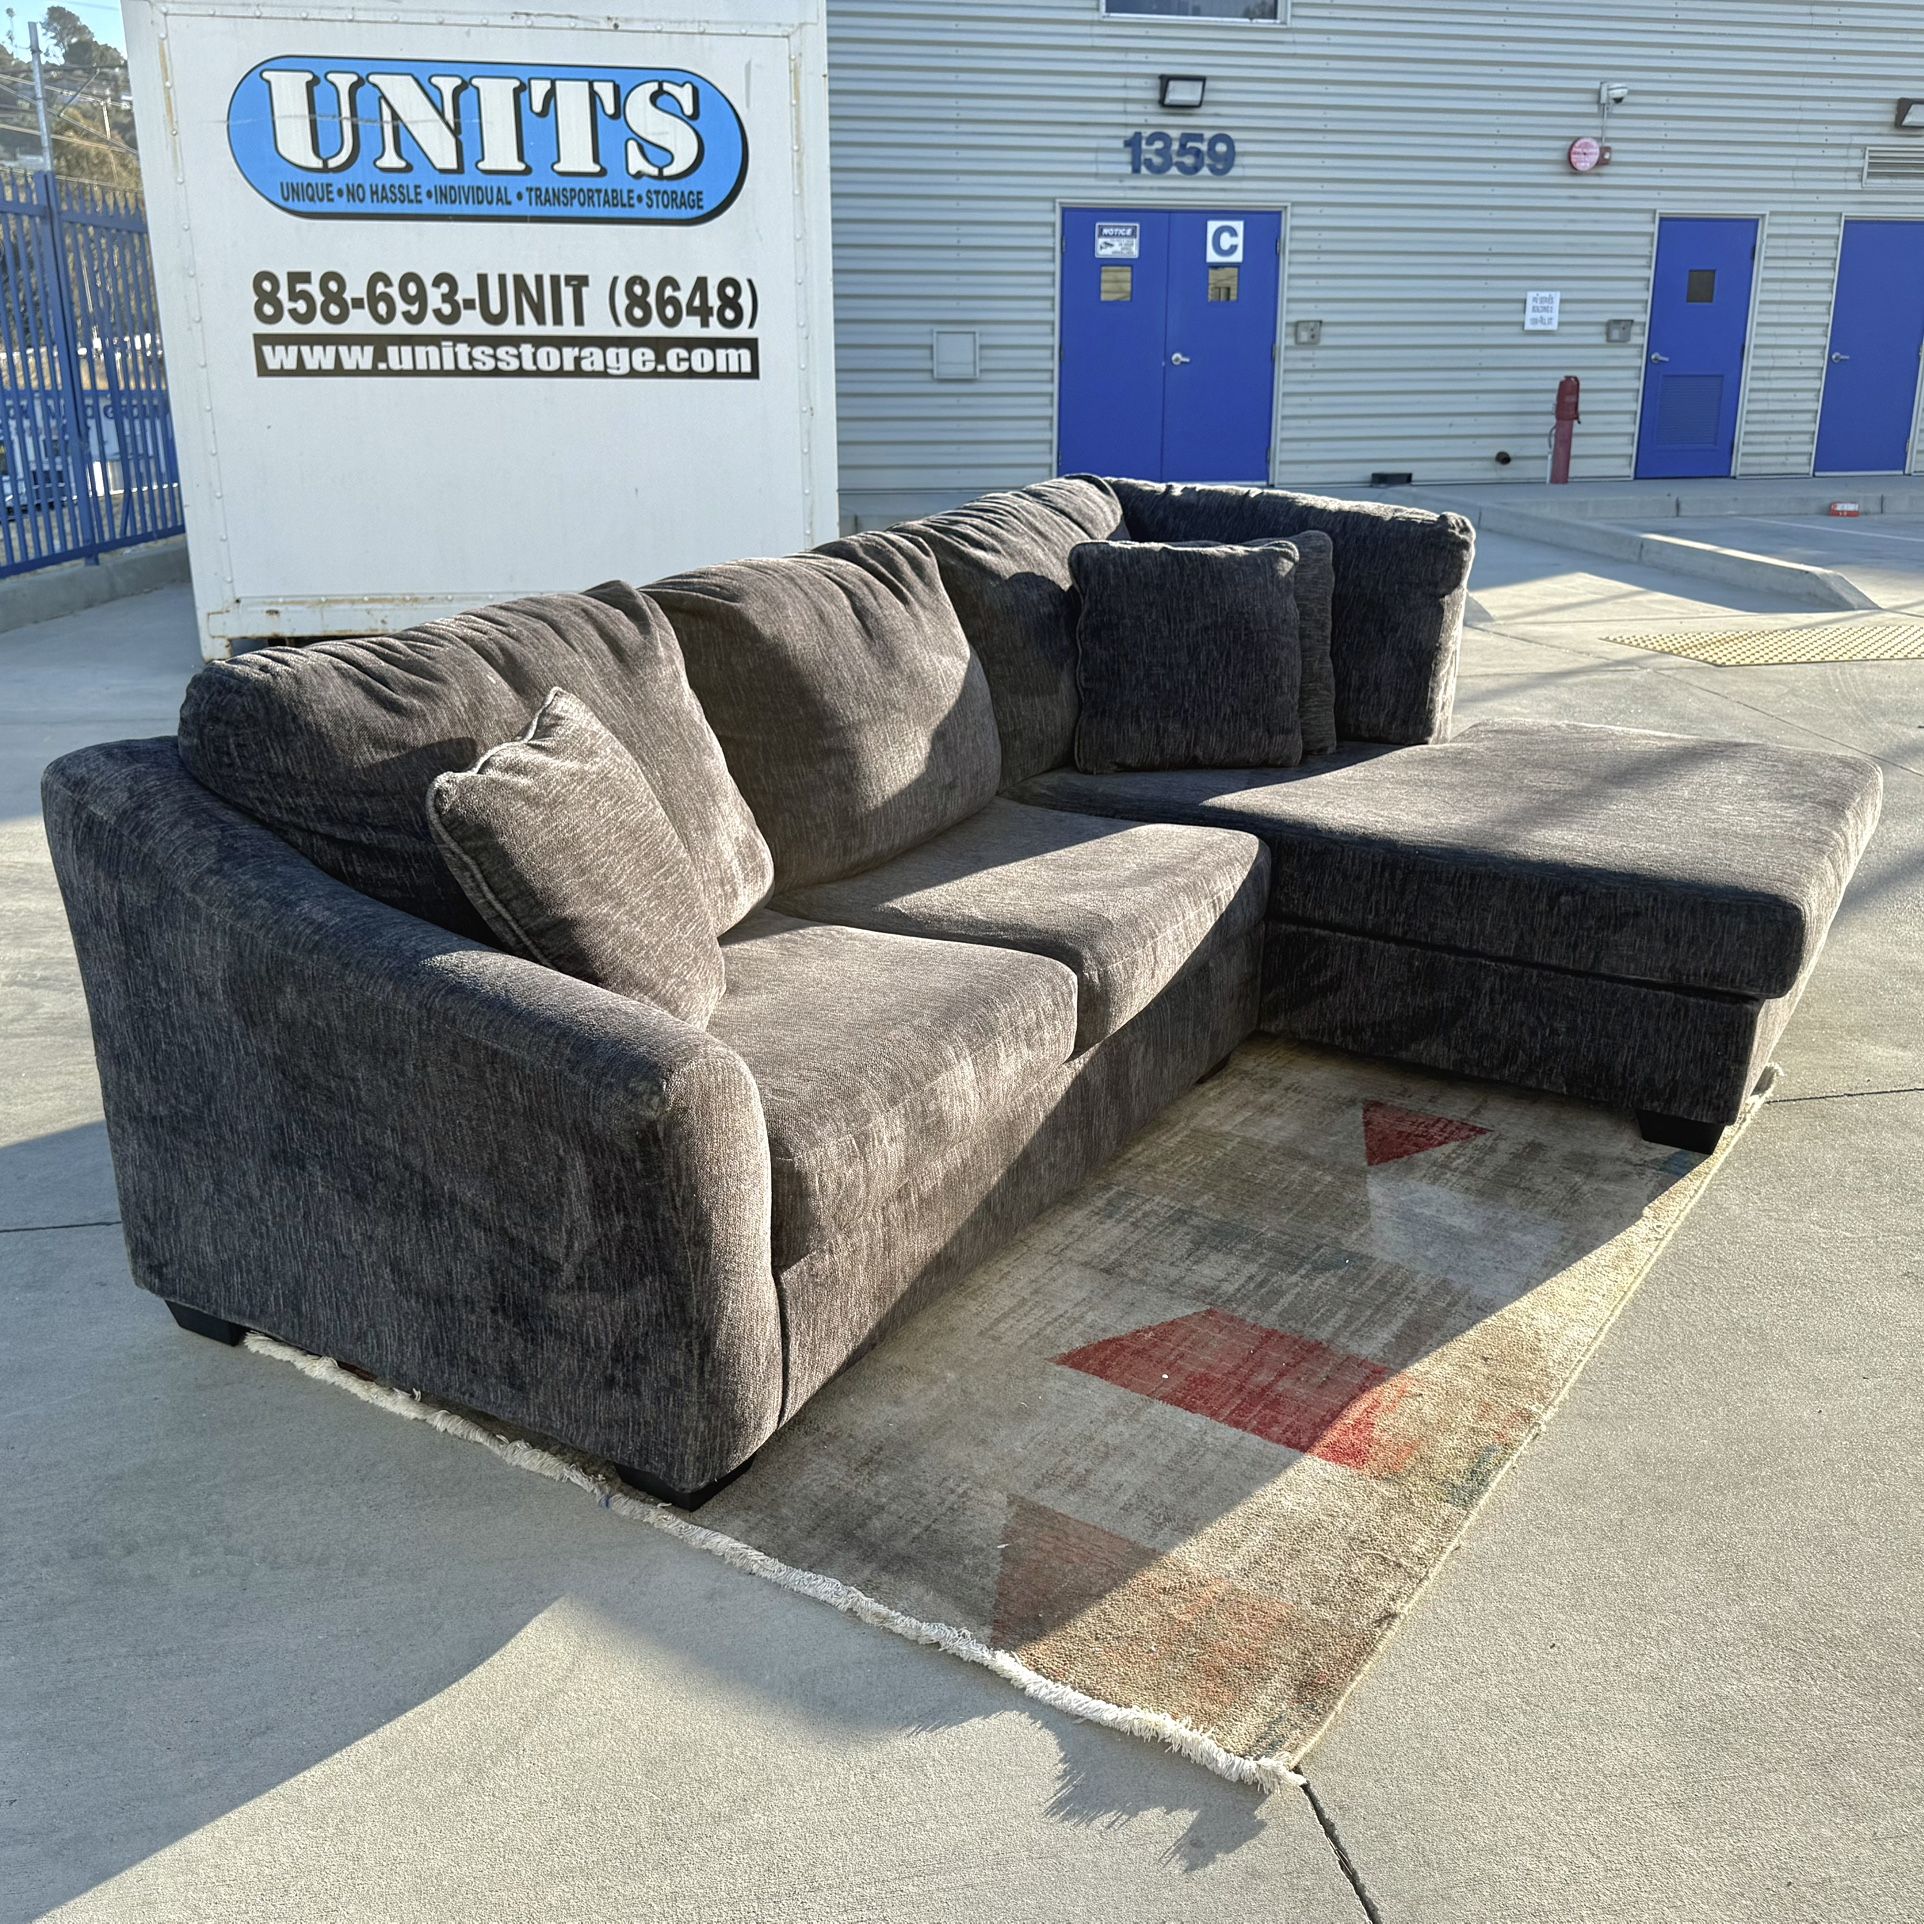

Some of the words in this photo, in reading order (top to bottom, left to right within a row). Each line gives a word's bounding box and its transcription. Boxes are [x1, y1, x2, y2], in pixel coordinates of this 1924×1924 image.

[261, 69, 706, 179] UNITS
[1123, 131, 1237, 176] 1359
[280, 181, 335, 203] UNIQUE
[346, 183, 366, 203] NO
[370, 184, 423, 205] HASSLE
[434, 185, 512, 206] INDIVIDUAL
[526, 187, 635, 208] TRANSPORTABLE
[645, 190, 704, 211] STORAGE
[1102, 227, 1133, 237] NOTICE
[1211, 224, 1239, 258] C
[252, 270, 590, 327] 858-693-UNIT
[609, 275, 759, 330] (8648)
[261, 341, 752, 376] www.unitsstorage.com
